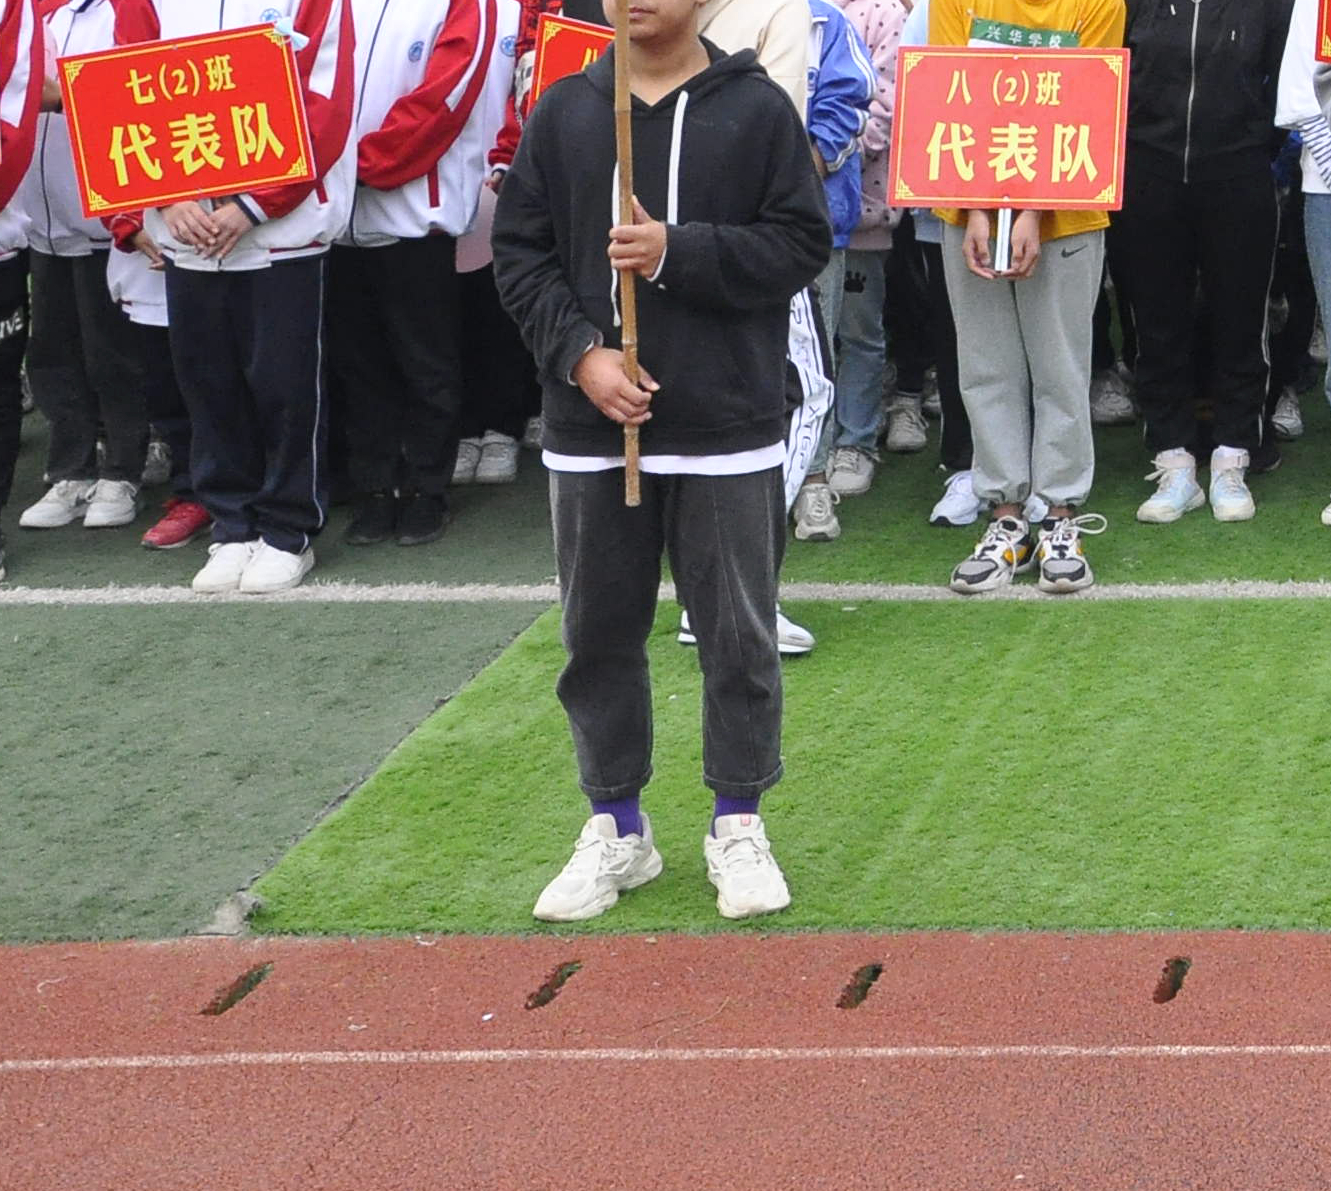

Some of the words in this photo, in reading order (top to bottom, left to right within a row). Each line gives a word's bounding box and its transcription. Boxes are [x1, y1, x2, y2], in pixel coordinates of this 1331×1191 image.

[986, 25, 1062, 48] 兴华学校
[109, 102, 285, 187] 代表队
[926, 122, 1099, 183] 代表队
